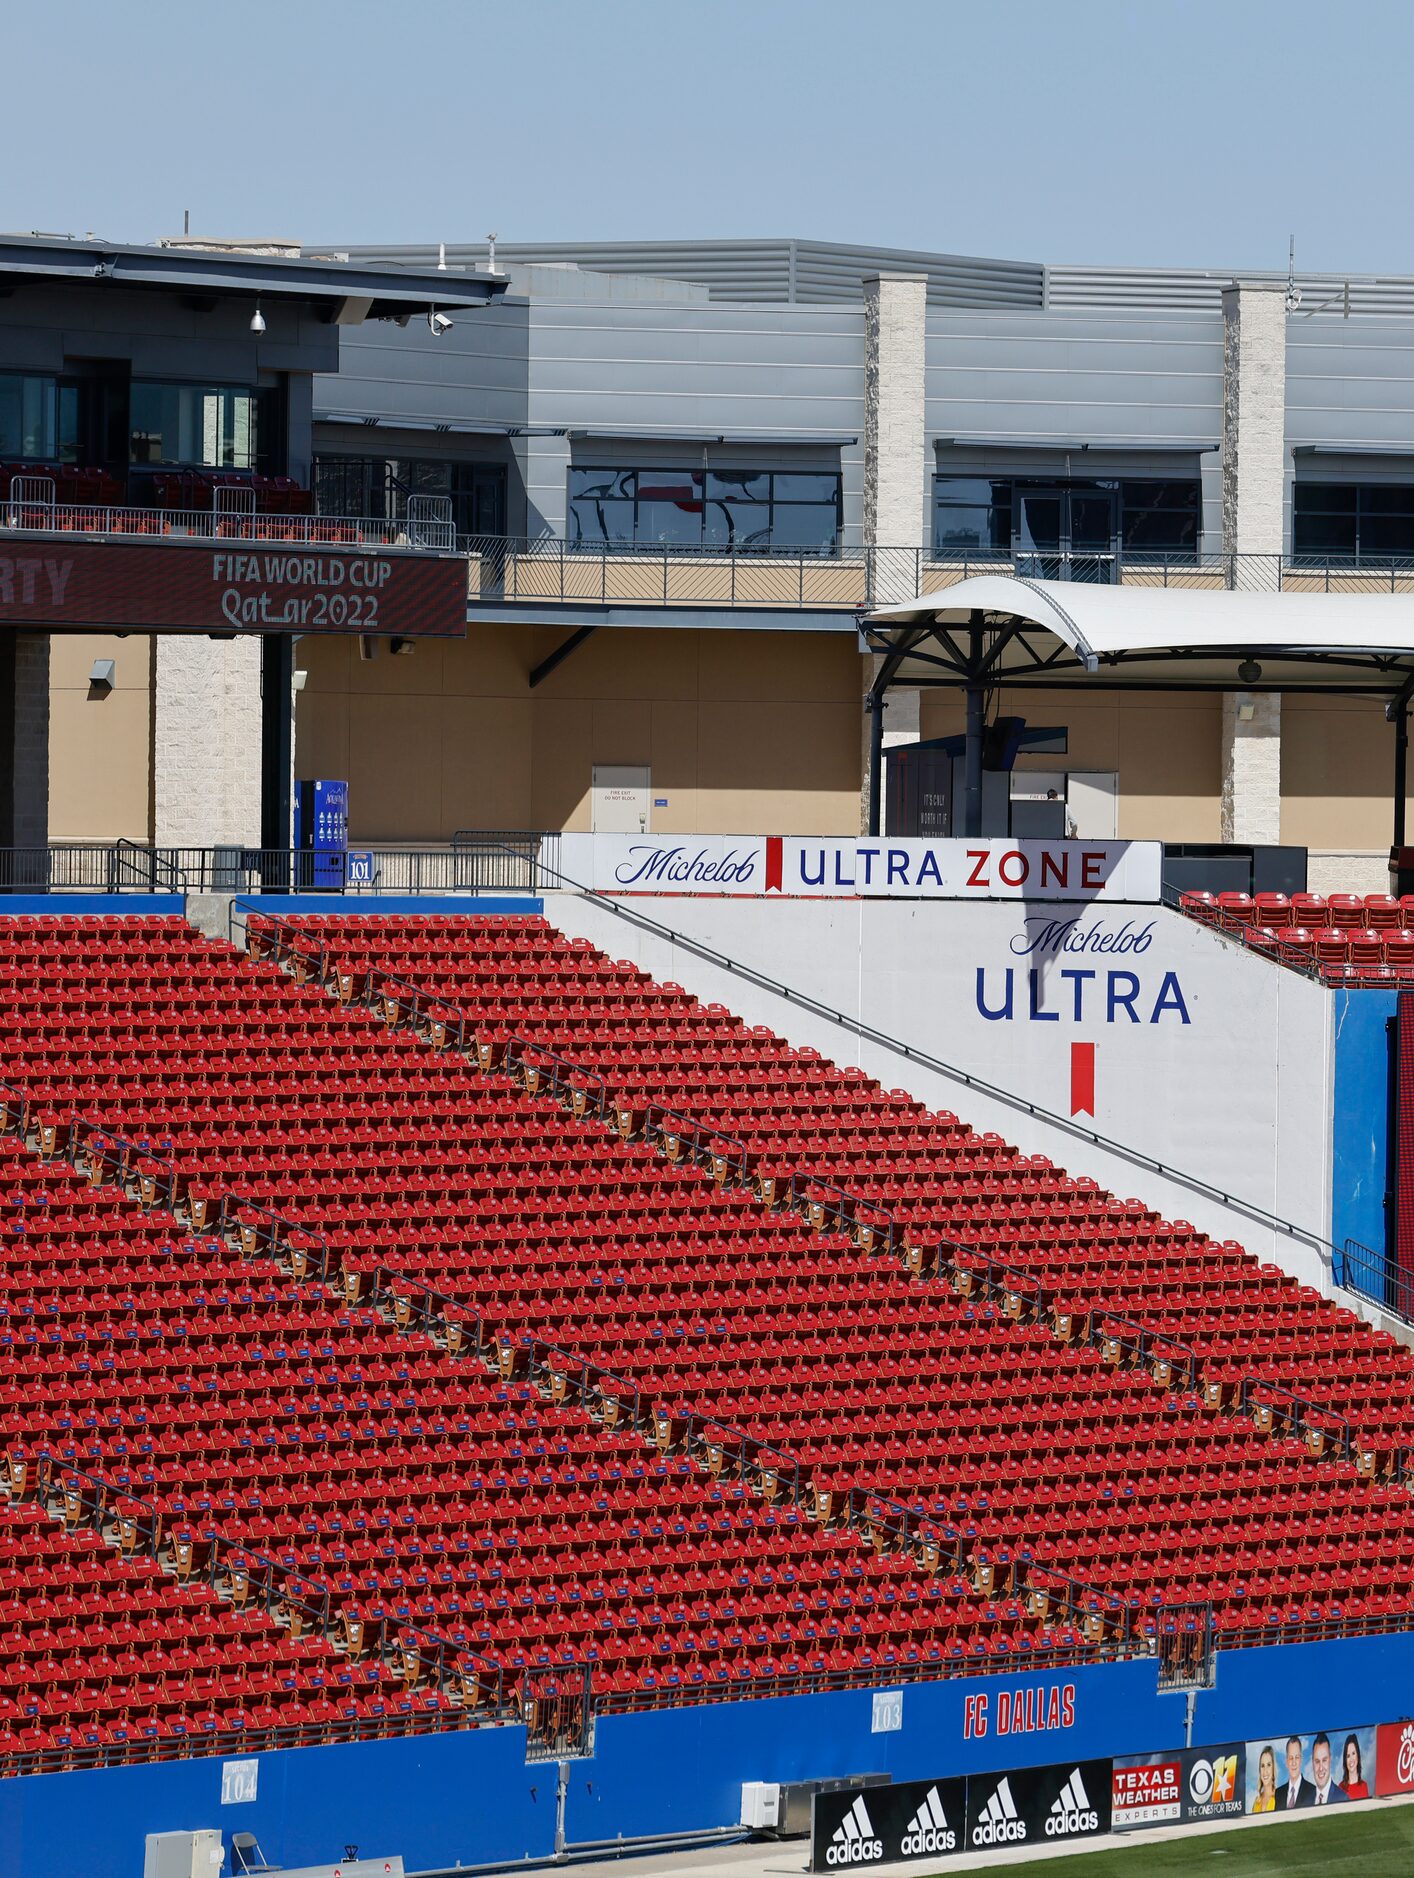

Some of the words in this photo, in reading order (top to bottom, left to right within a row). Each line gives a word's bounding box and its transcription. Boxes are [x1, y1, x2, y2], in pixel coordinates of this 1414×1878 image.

[213, 555, 261, 583] FIFA
[264, 556, 345, 586] WORLD
[349, 560, 392, 588] CUP
[350, 861, 369, 880] 101
[615, 846, 761, 884] Michelob
[799, 848, 943, 887] ULTRA
[966, 850, 1107, 889] ZONE
[1010, 917, 1158, 955] Michelob
[976, 968, 1191, 1024] ULTRA
[874, 1704, 900, 1730] 103
[963, 1693, 988, 1740] FC
[996, 1683, 1076, 1736] DALLAS
[223, 1774, 255, 1801] 104
[1115, 1768, 1175, 1790] TEXAS
[1113, 1785, 1179, 1806] WEATHER
[1187, 1806, 1197, 1817] THE
[1198, 1804, 1214, 1816] ONES
[1214, 1802, 1225, 1814] FOR
[1225, 1800, 1243, 1813] TEXAS
[1044, 1808, 1098, 1836] adidas
[1115, 1807, 1178, 1822] EXPERTS
[900, 1828, 956, 1855] adidas
[972, 1818, 1027, 1846] adidas
[826, 1839, 884, 1865] adidas
